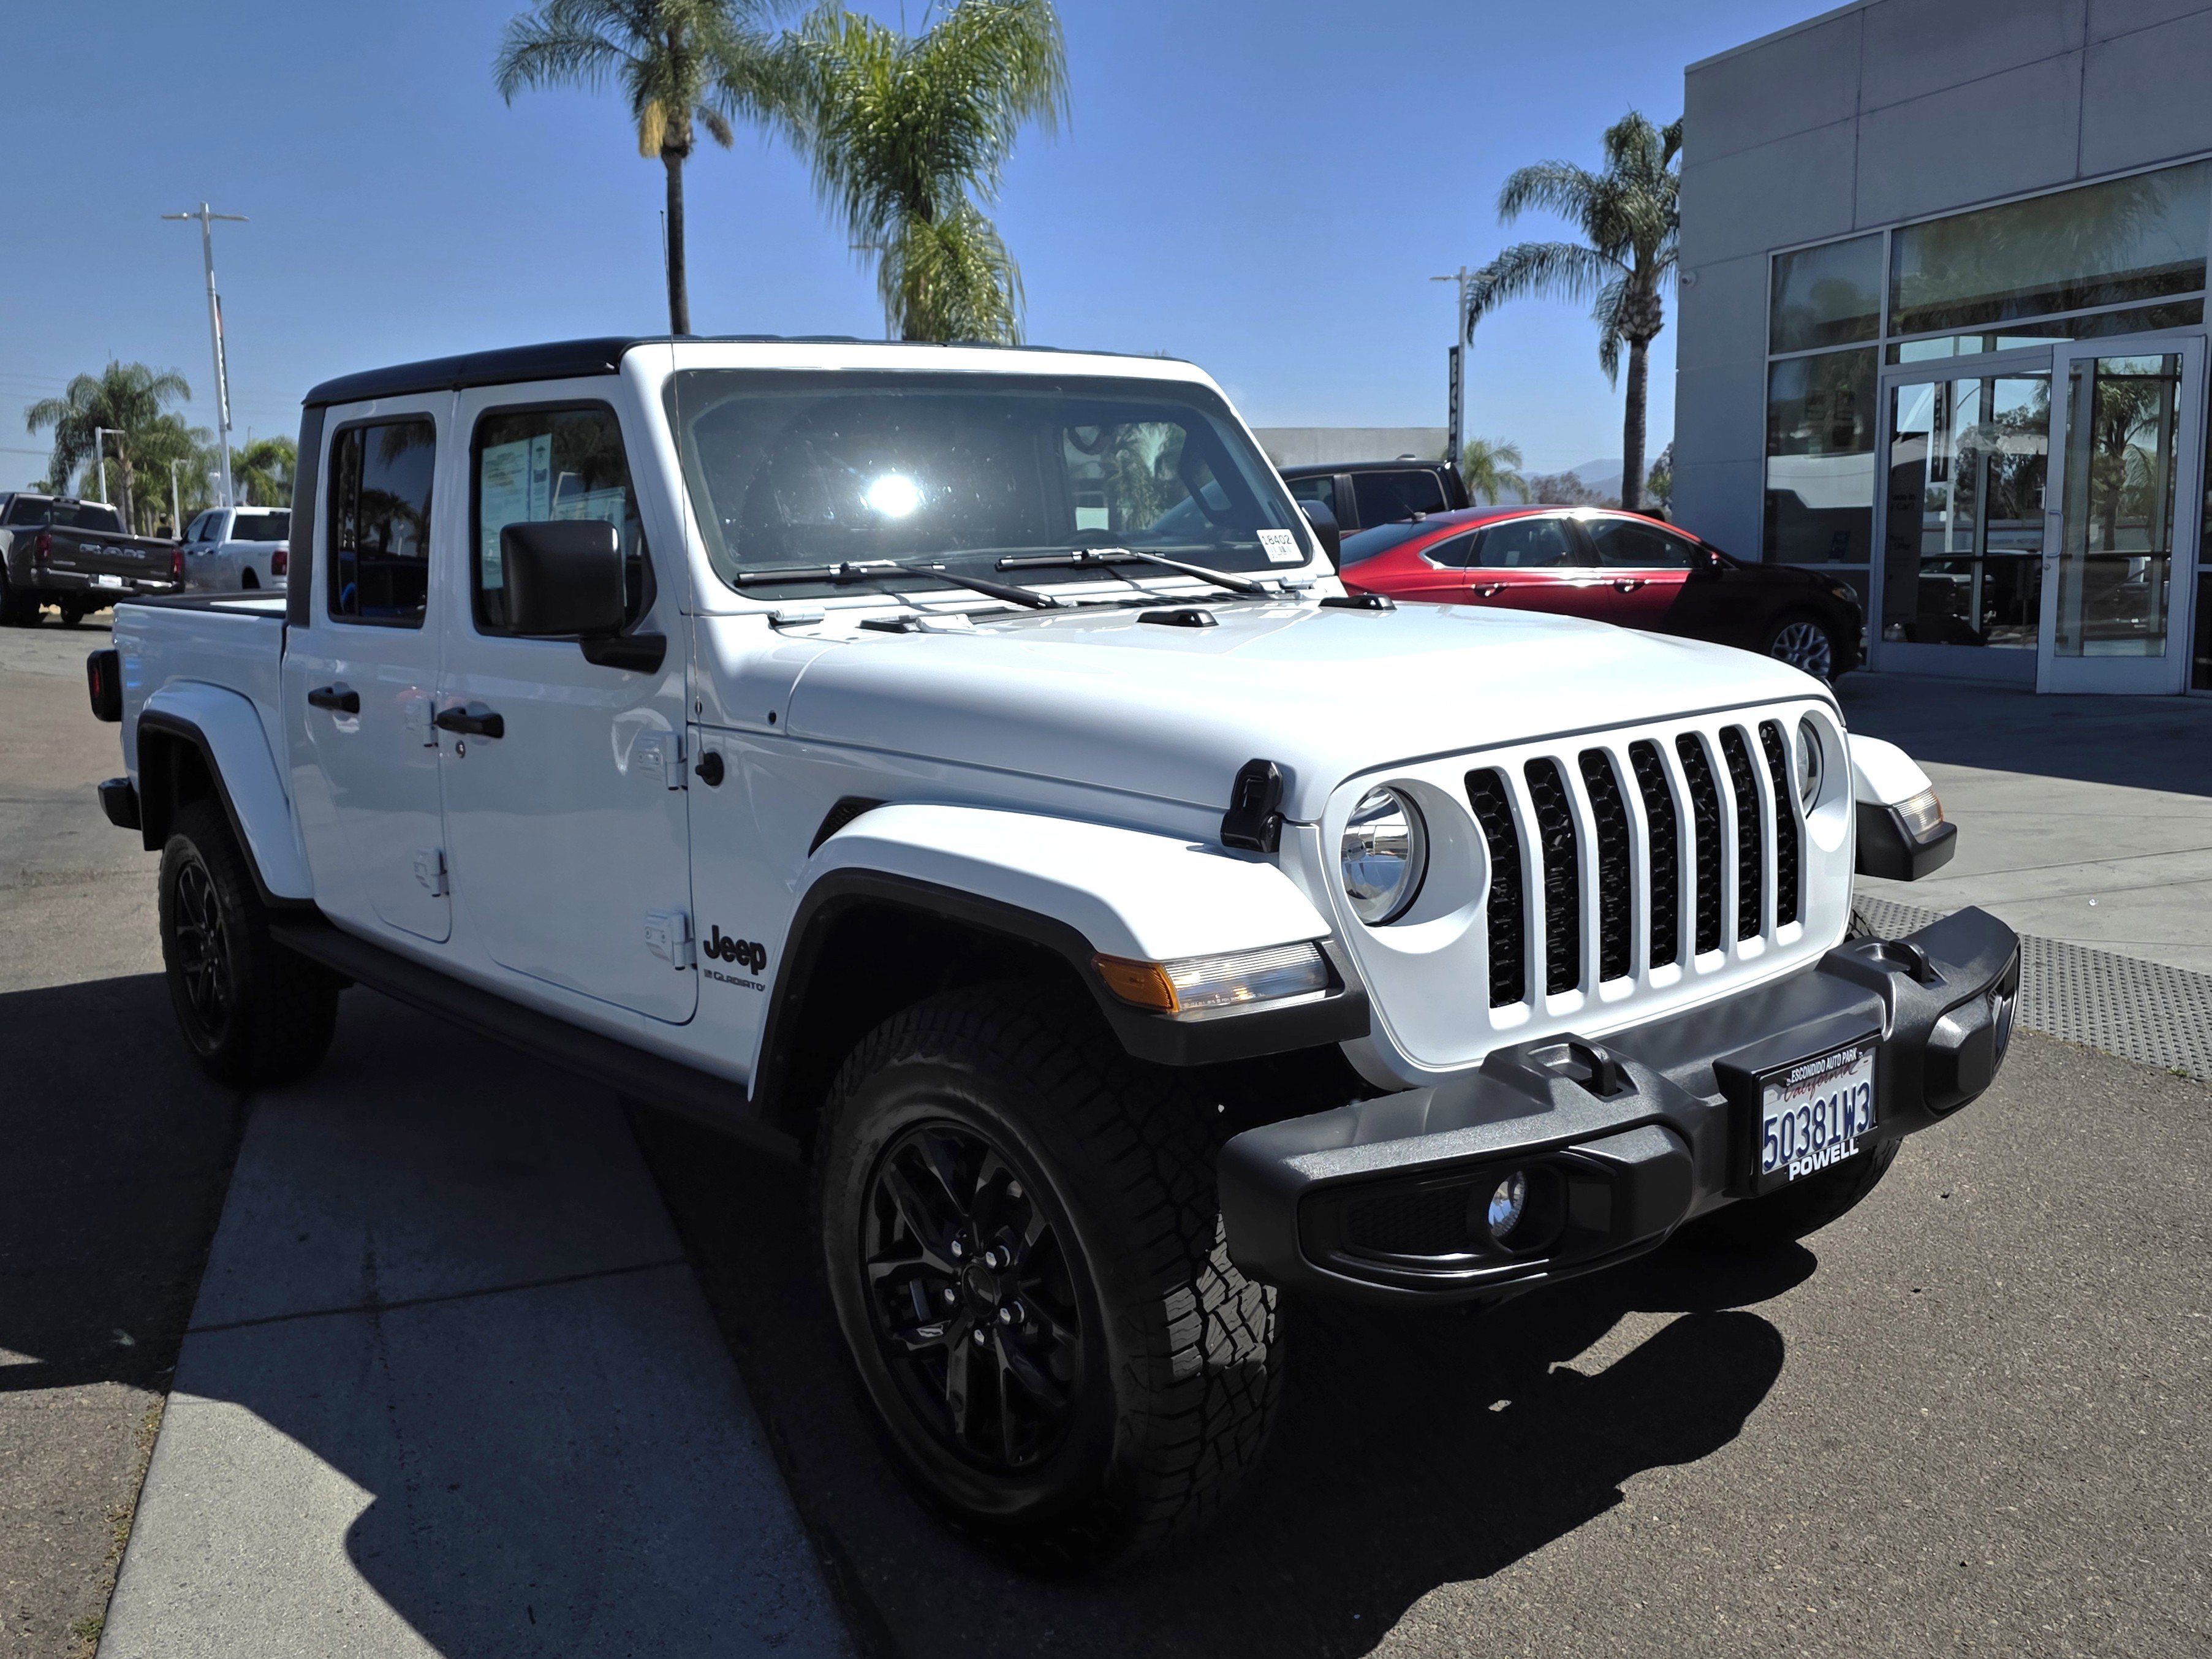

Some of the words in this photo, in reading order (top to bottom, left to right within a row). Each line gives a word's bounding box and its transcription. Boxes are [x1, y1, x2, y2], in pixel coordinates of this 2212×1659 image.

[1262, 534, 1292, 545] 18402
[703, 924, 767, 976] Jeep
[713, 971, 766, 992] GLADIATO
[1791, 1059, 1825, 1084] ESCONDIDO
[1826, 1053, 1841, 1071] AUTO
[1842, 1047, 1858, 1066] PARK
[1763, 1081, 1870, 1172] 50381W3
[1789, 1137, 1859, 1181] POWELL
